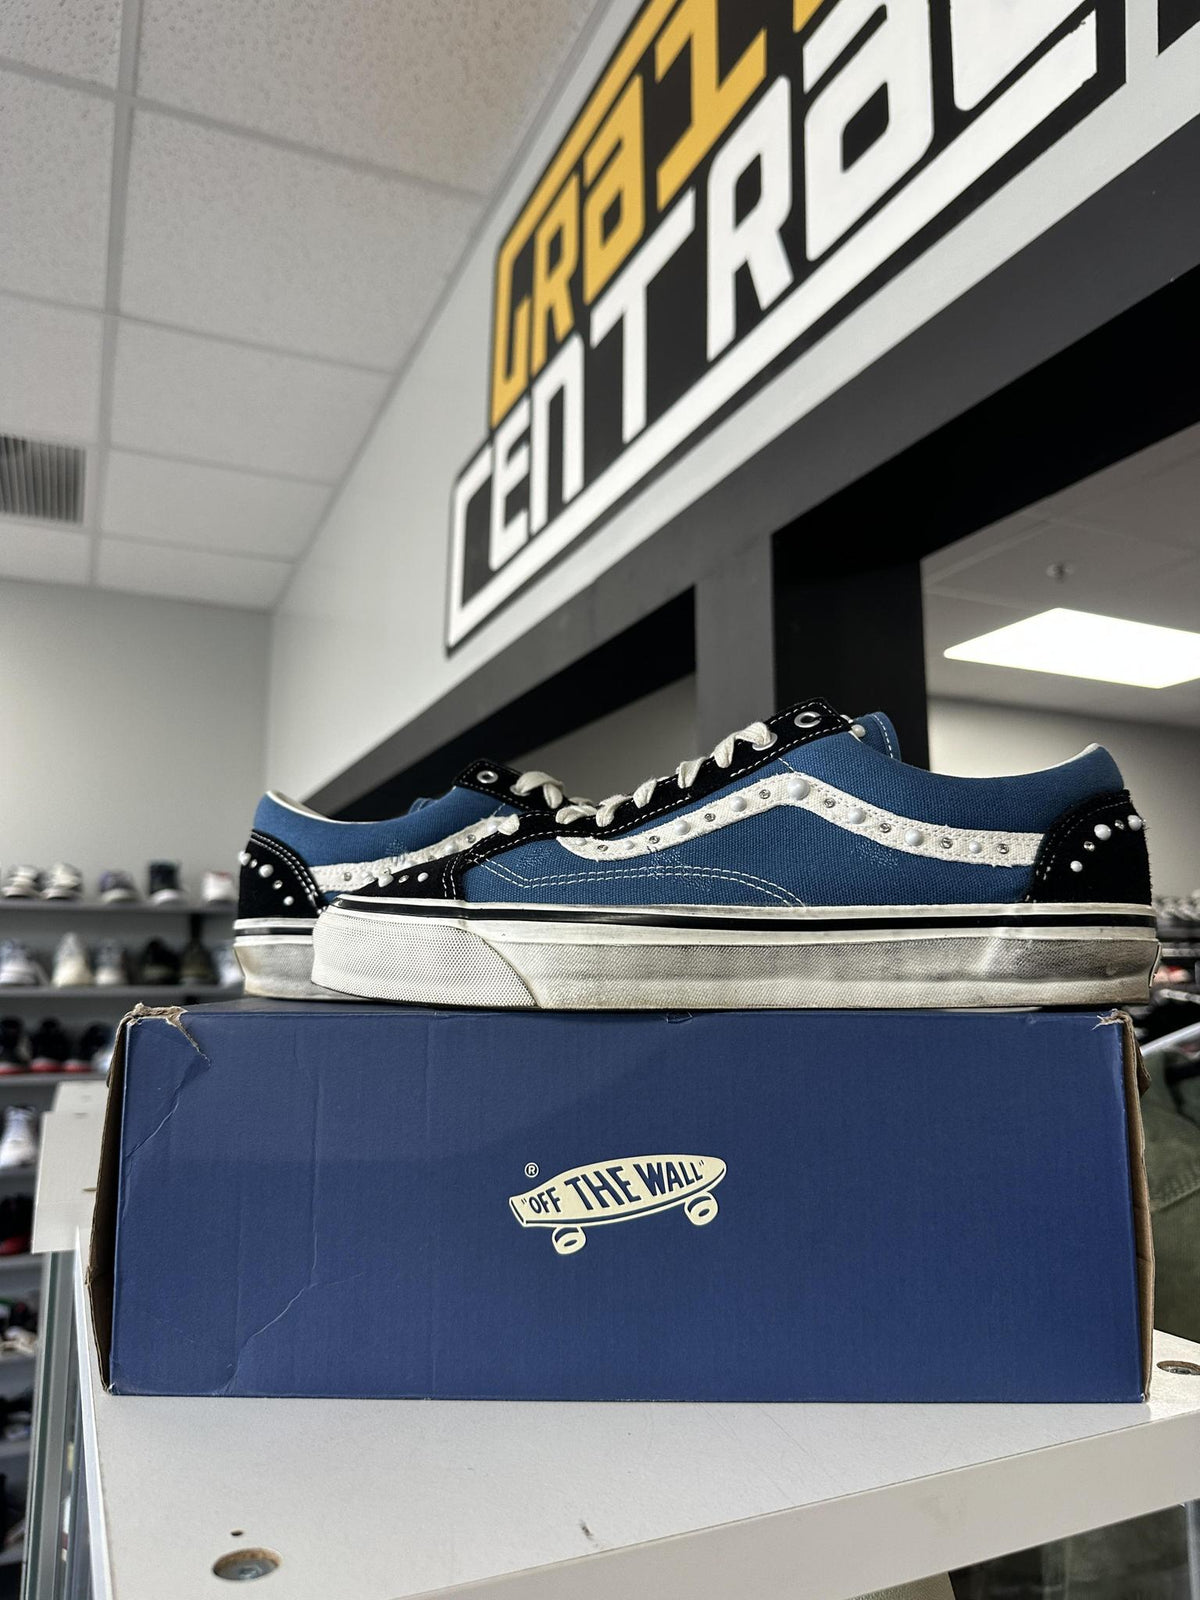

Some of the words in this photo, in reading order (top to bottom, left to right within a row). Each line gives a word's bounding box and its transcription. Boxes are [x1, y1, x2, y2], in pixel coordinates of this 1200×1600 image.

[521, 1186, 562, 1215] "OFF
[564, 1166, 642, 1211] THE
[633, 1159, 705, 1197] WALL"
